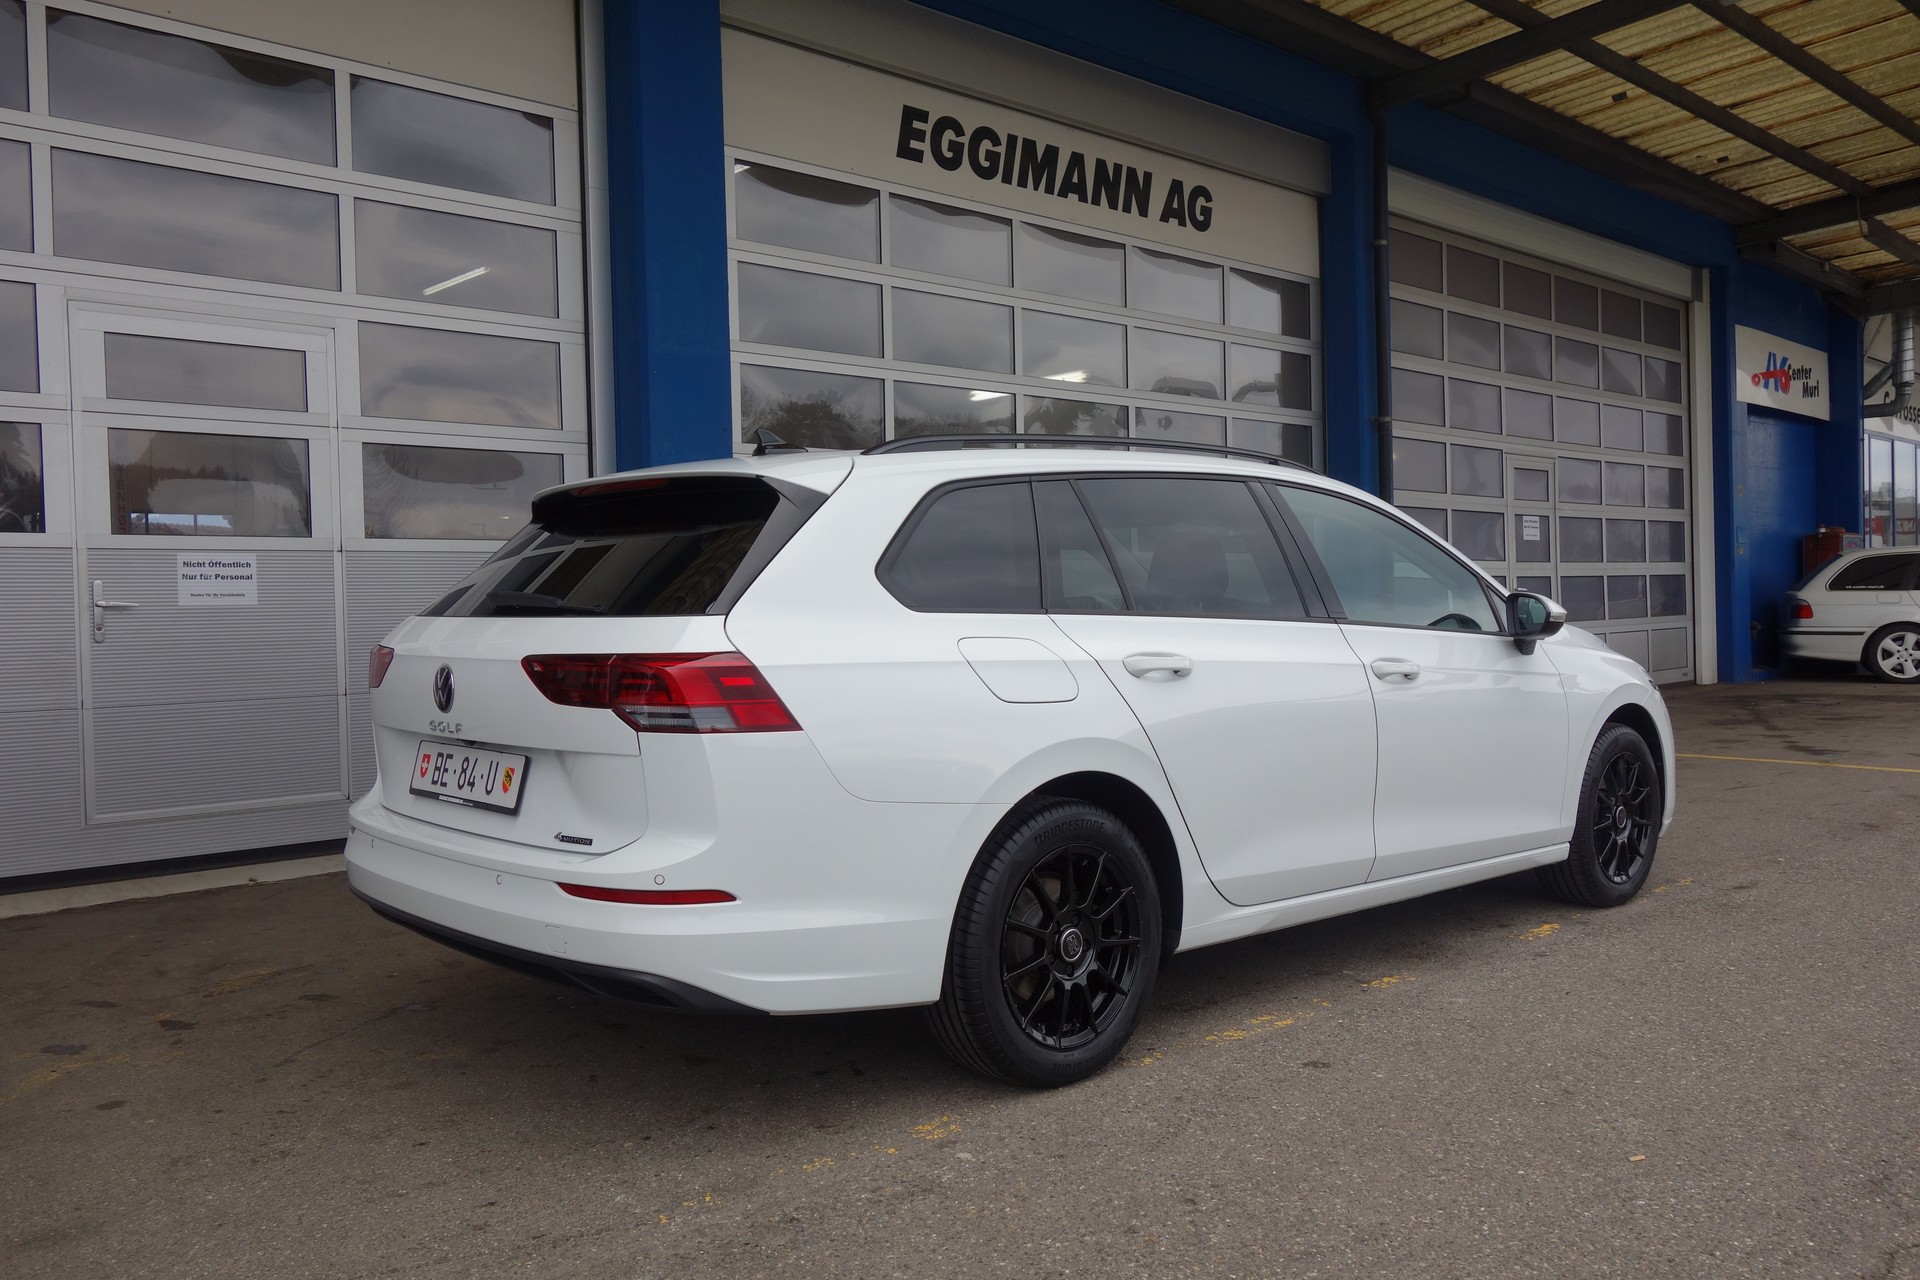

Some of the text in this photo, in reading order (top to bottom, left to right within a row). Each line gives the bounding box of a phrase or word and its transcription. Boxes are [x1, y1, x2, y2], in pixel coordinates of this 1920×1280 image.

[896, 104, 1213, 232] EGGIMANN AG
[1787, 363, 1812, 381] Center
[1802, 380, 1820, 399] Muri
[182, 559, 252, 569] Nicht Öffentlich
[181, 573, 198, 581] Nur
[214, 573, 253, 581] Personal
[429, 720, 463, 735] GOLF
